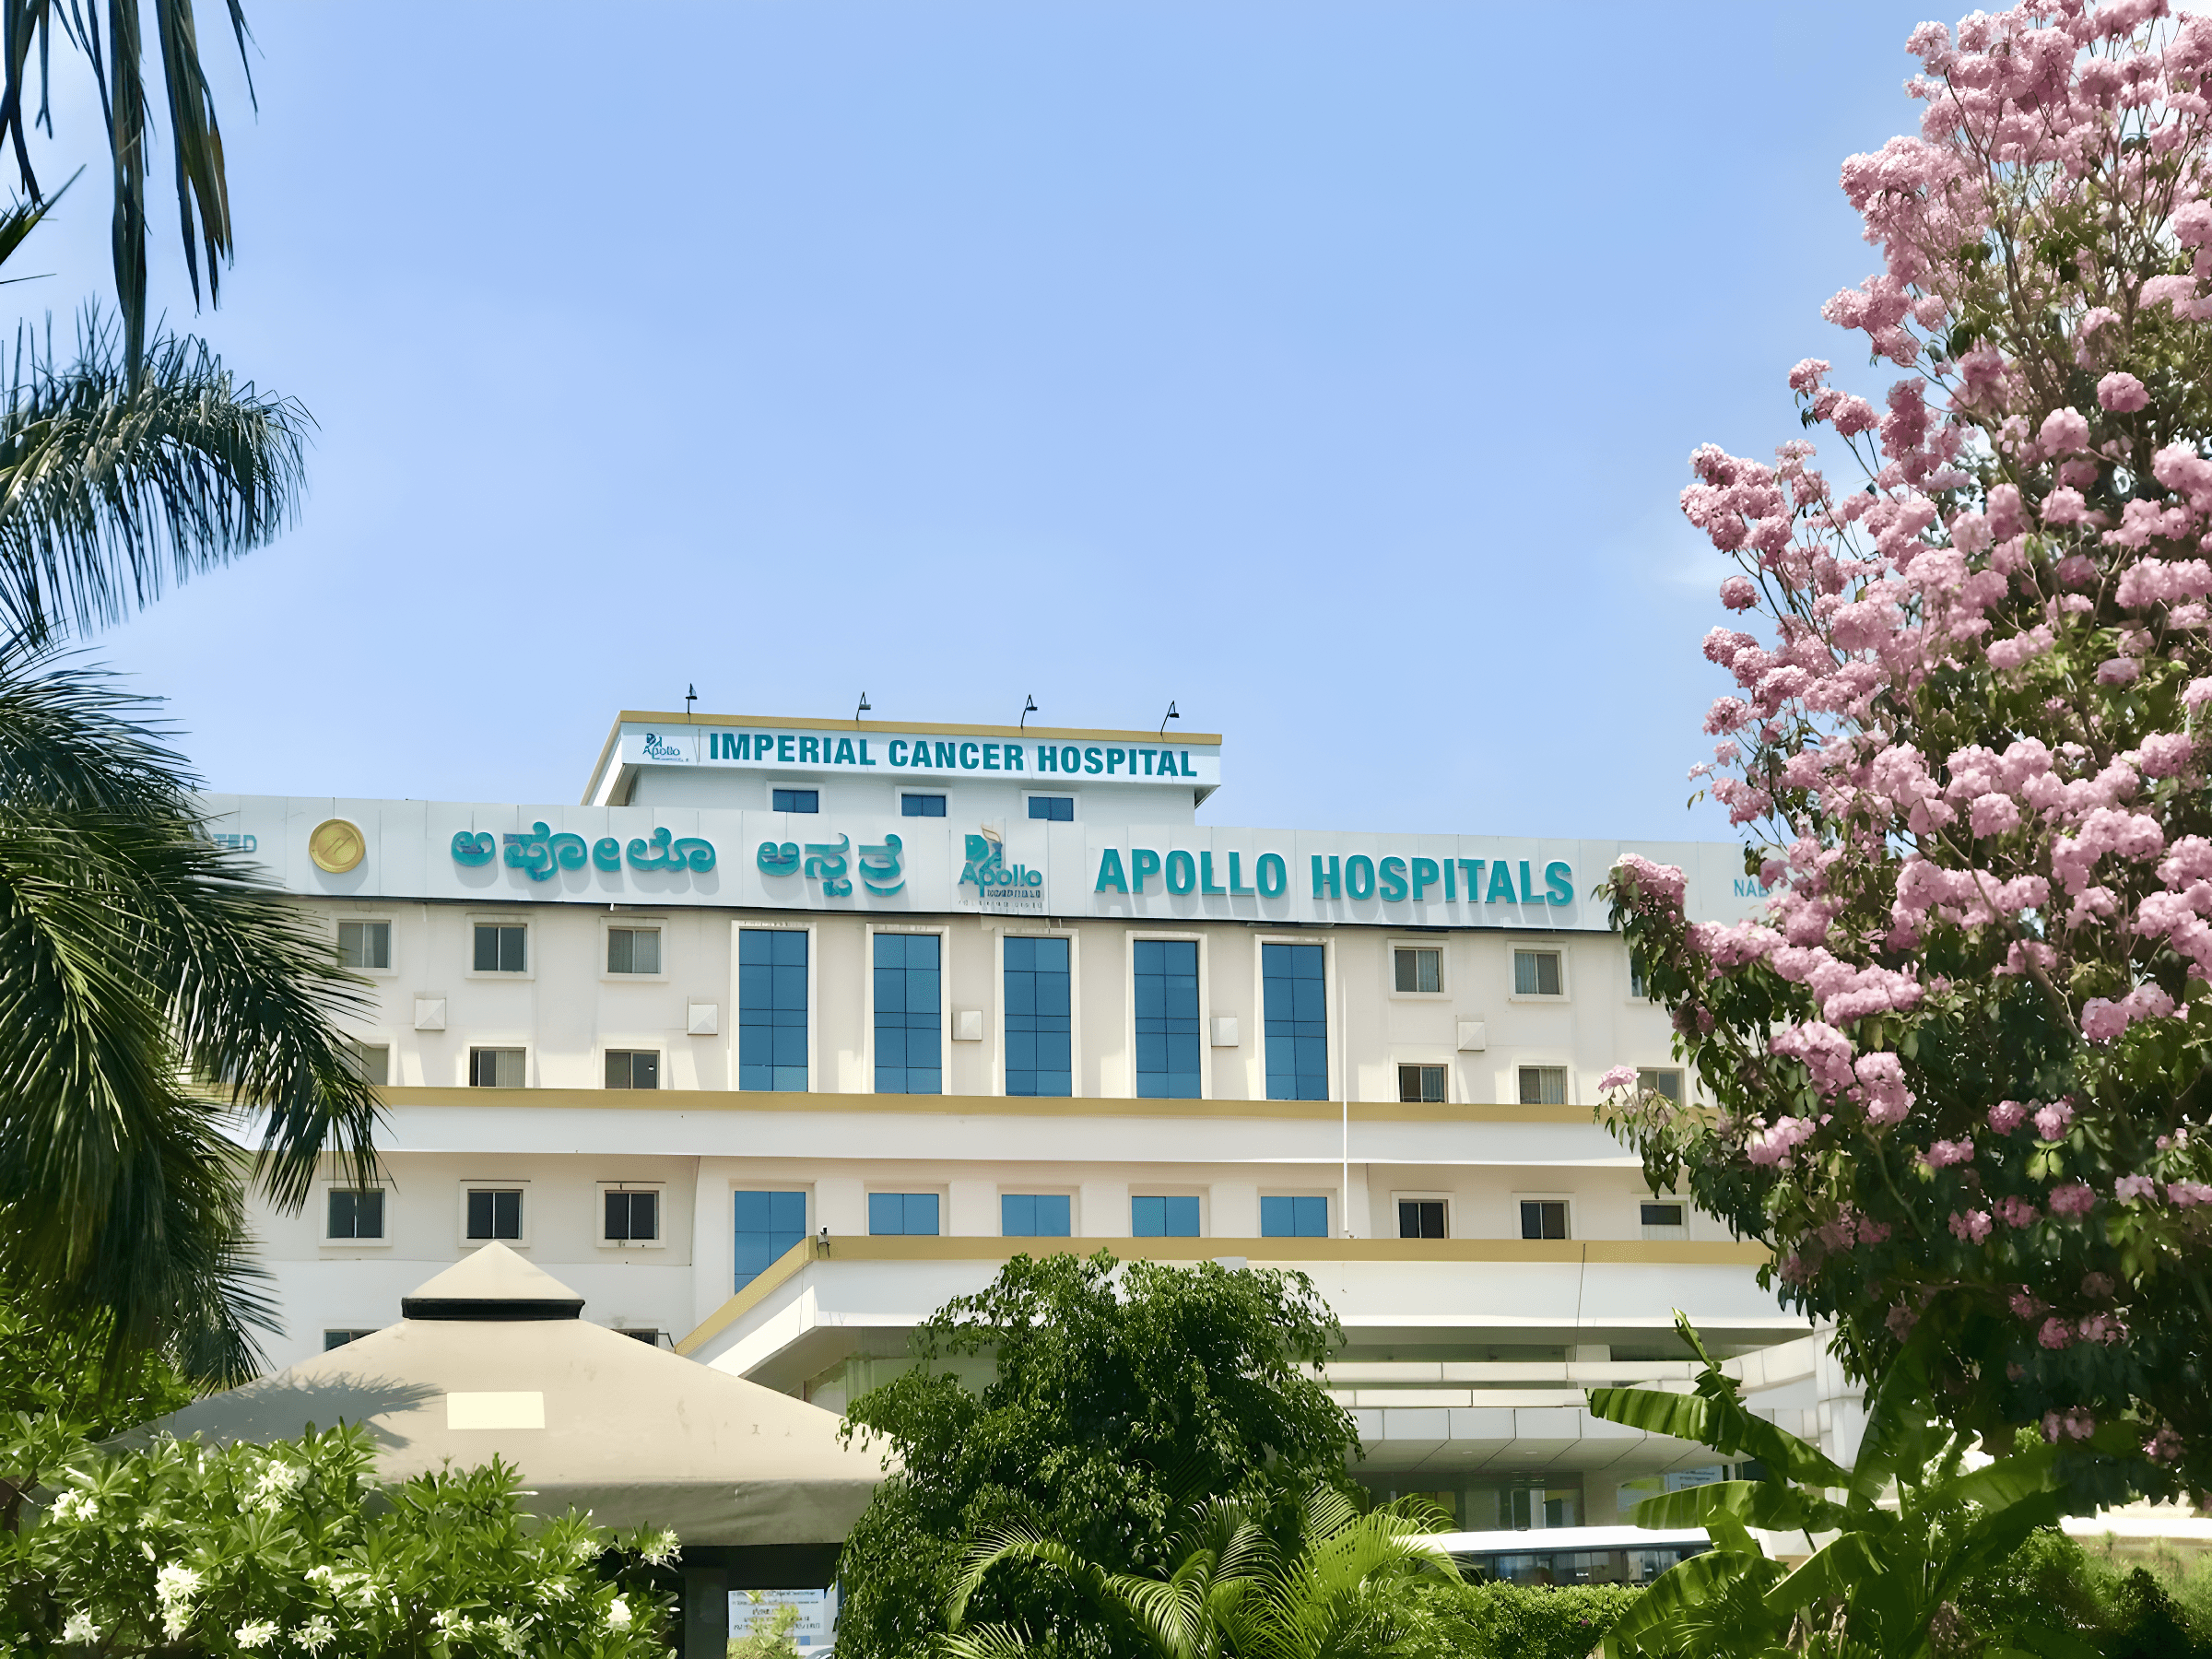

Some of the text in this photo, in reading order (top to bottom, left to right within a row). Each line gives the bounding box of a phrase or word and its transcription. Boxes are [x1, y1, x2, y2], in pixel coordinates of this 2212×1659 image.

[710, 733, 1198, 778] IMPERIAL CANCER HOSPITAL
[958, 863, 1043, 898] Apollo
[1094, 848, 1575, 907] APOLLO HOSPITALS
